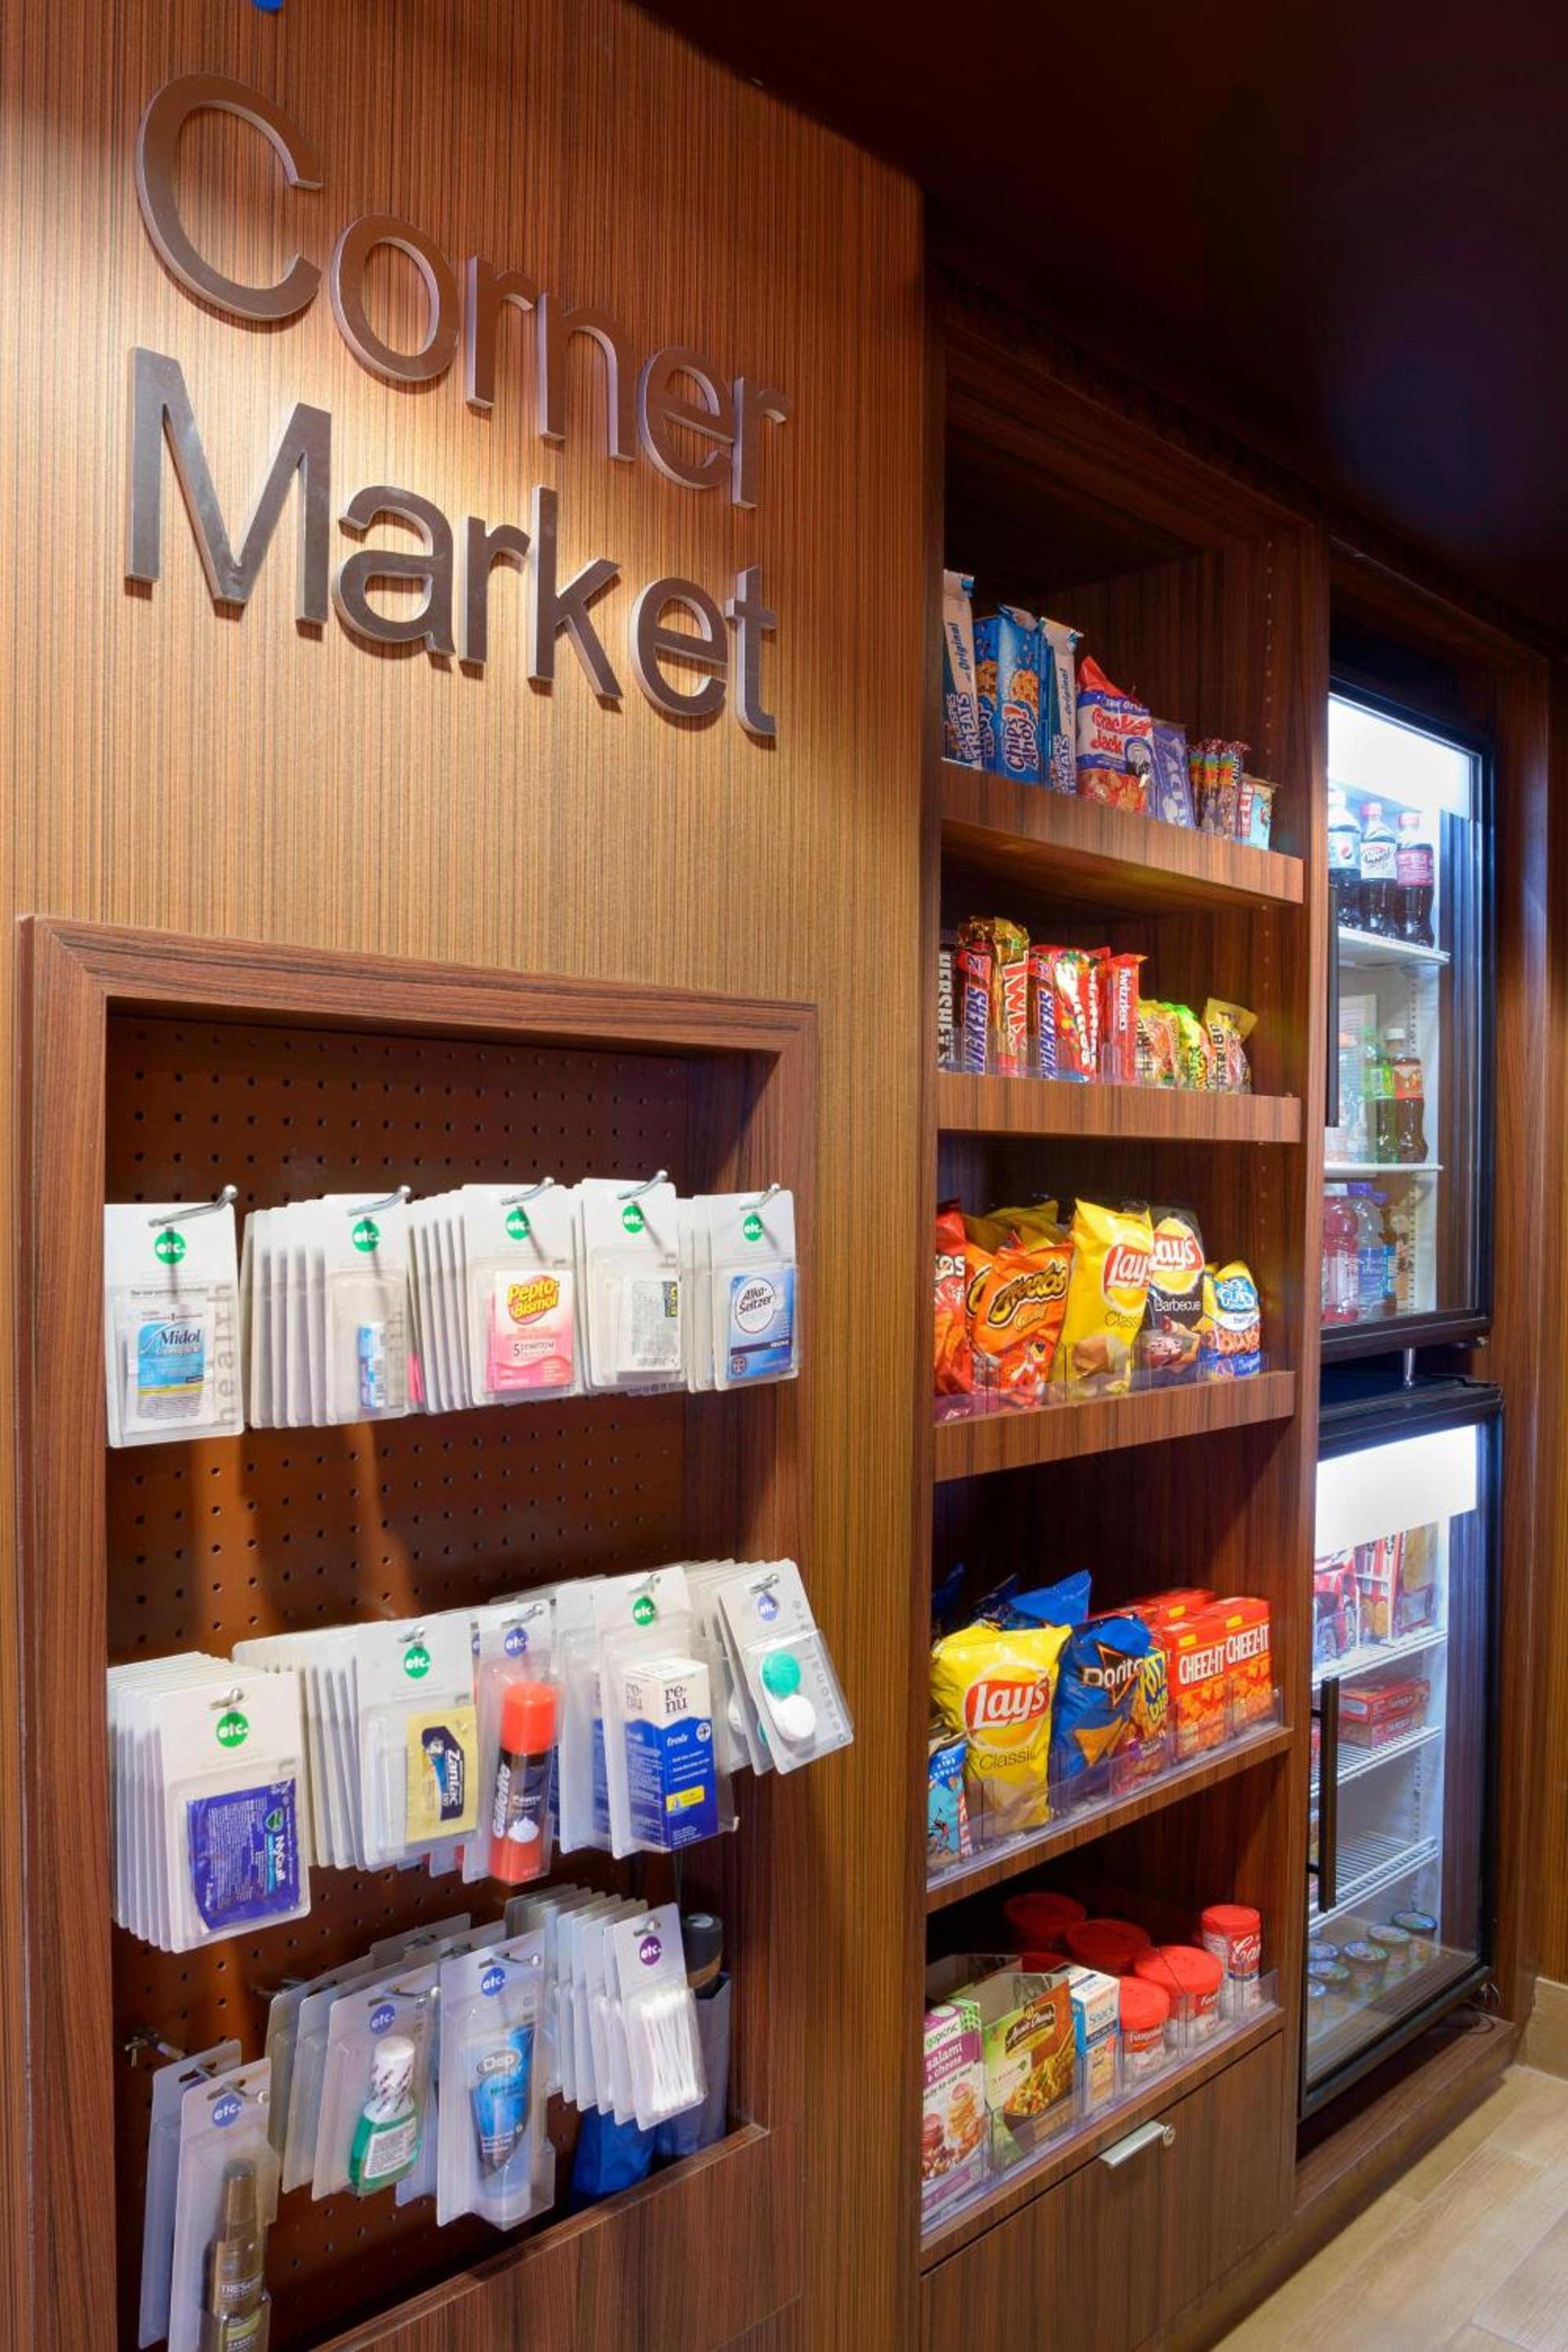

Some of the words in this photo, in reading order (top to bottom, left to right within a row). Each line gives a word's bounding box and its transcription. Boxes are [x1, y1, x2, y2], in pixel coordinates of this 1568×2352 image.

[136, 72, 792, 510] Corner
[127, 345, 777, 737] Market
[947, 621, 970, 671] Original
[1091, 706, 1152, 737] Cracker
[1005, 715, 1024, 771] Chips
[1089, 728, 1124, 755] Jack
[1001, 949, 1029, 1056] TWIX
[964, 985, 990, 1075] NICKERS
[1038, 989, 1057, 1079] NICKERS
[1107, 1245, 1152, 1289] Lay
[507, 1277, 560, 1305] Pepto-
[738, 1294, 773, 1315] Seltzer
[514, 1293, 559, 1319] Bismol
[1153, 1298, 1201, 1312] Barbecue
[1104, 1311, 1142, 1330] Class
[160, 1329, 201, 1346] Midol
[513, 1343, 520, 1357] 5
[634, 1604, 656, 1619] etc.
[505, 1636, 529, 1650] etc.
[1226, 1623, 1270, 1665] CHEEZ-IT
[405, 1653, 431, 1669] etc.
[1082, 1657, 1143, 1687] Dorito
[1178, 1645, 1226, 1686] CHEEZ-IT
[665, 1697, 688, 1714] nu
[973, 1677, 1049, 1729] Lay's
[217, 1722, 249, 1740] etc.
[448, 1748, 460, 1806] Zantac
[492, 1763, 510, 1838] Gillette
[640, 1944, 662, 1959] etc.
[482, 1973, 506, 1990] etc.
[372, 2011, 395, 2029] etc.
[483, 2052, 515, 2071] Dep
[925, 2038, 963, 2072] salami
[214, 2102, 243, 2121] etc.
